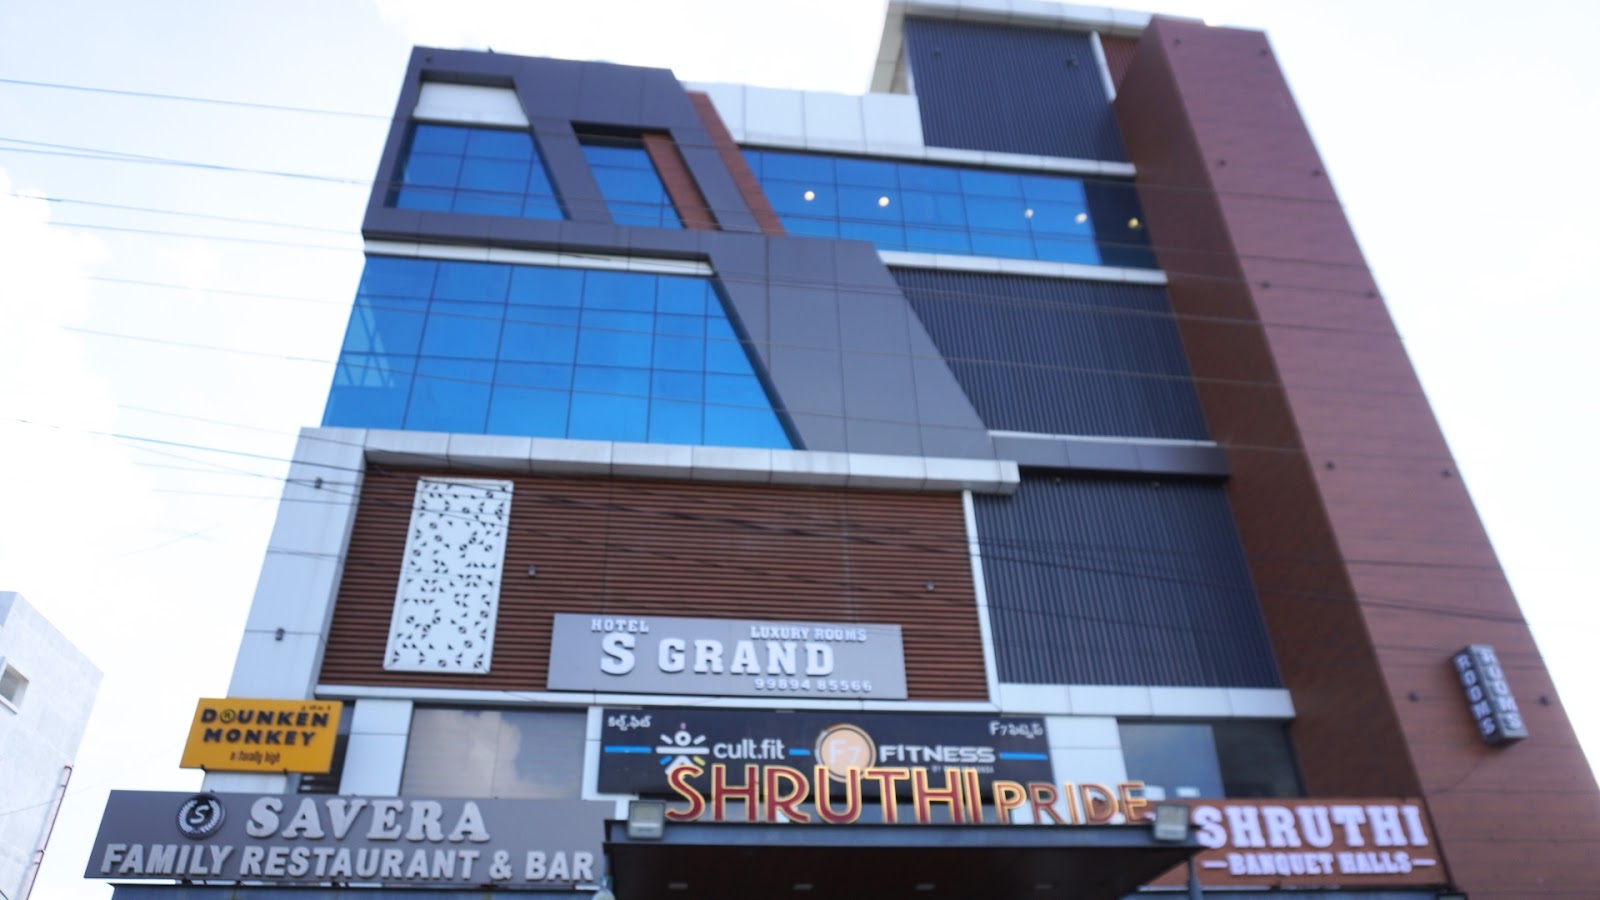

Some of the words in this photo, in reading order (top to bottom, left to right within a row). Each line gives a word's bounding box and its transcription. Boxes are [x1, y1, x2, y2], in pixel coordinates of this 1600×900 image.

[591, 618, 649, 632] HOTEL
[751, 626, 808, 640] LUXURY
[814, 628, 866, 641] ROOMS
[600, 633, 635, 674] S
[658, 638, 834, 676] GRAND
[755, 678, 811, 692] 99894
[816, 680, 872, 693] 85566
[203, 728, 316, 746] MONKEY
[713, 738, 785, 759] cult.fit
[879, 743, 996, 763] FITNESS
[665, 763, 983, 825] SHRUTHI
[992, 780, 1150, 826] PRIDE
[246, 797, 490, 842] SAVERA
[1192, 805, 1428, 849] SHRUTHI
[101, 843, 234, 876] FAMILY
[240, 846, 479, 879] RESTAURANT
[488, 851, 512, 880] &
[525, 852, 594, 882] BAR
[1227, 853, 1333, 877] BANQUET
[1338, 851, 1412, 875] HALLS
